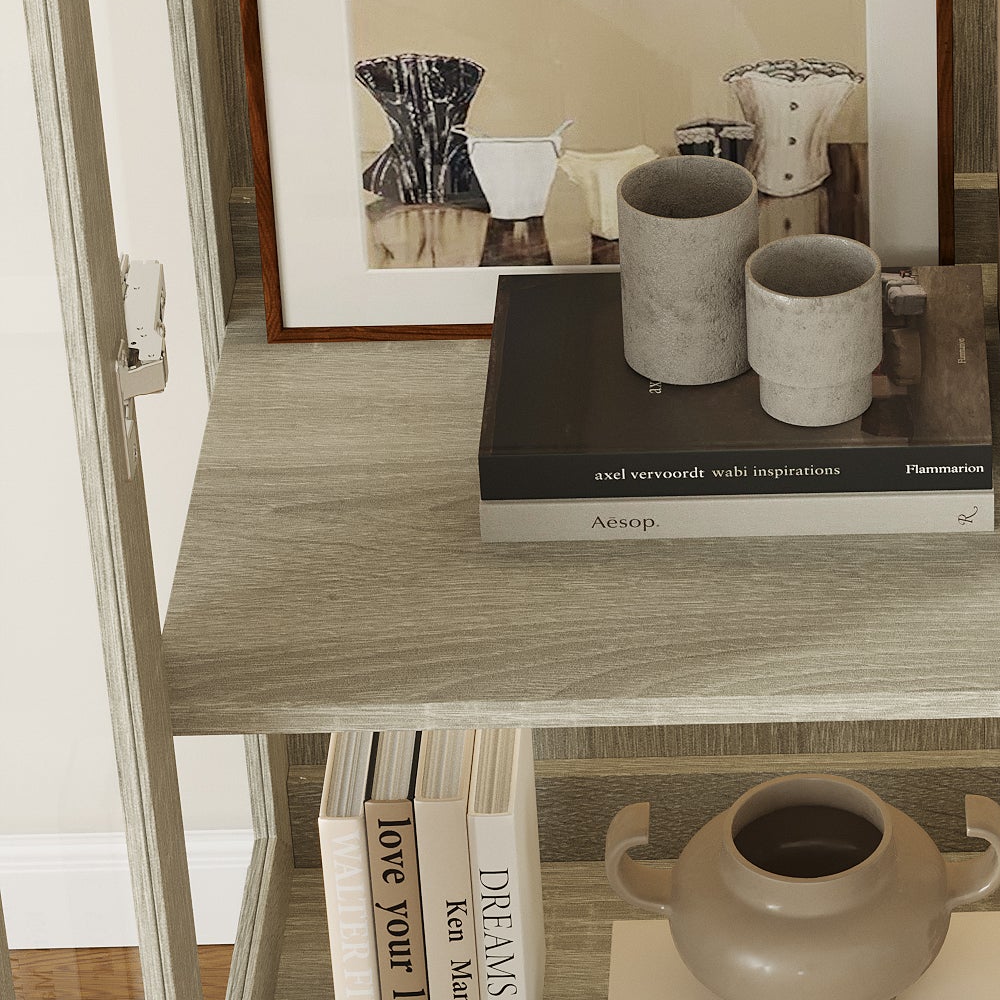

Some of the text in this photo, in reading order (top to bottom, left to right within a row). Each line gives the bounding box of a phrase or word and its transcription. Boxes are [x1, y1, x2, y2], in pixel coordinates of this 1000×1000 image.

[594, 463, 841, 481] axel vervoordt wabi inspirations
[905, 462, 985, 475] Flammarion
[377, 818, 411, 884] love
[330, 830, 370, 960] WALTER
[446, 899, 467, 942] Ken
[375, 900, 415, 973] your
[479, 868, 518, 997] DREAMS
